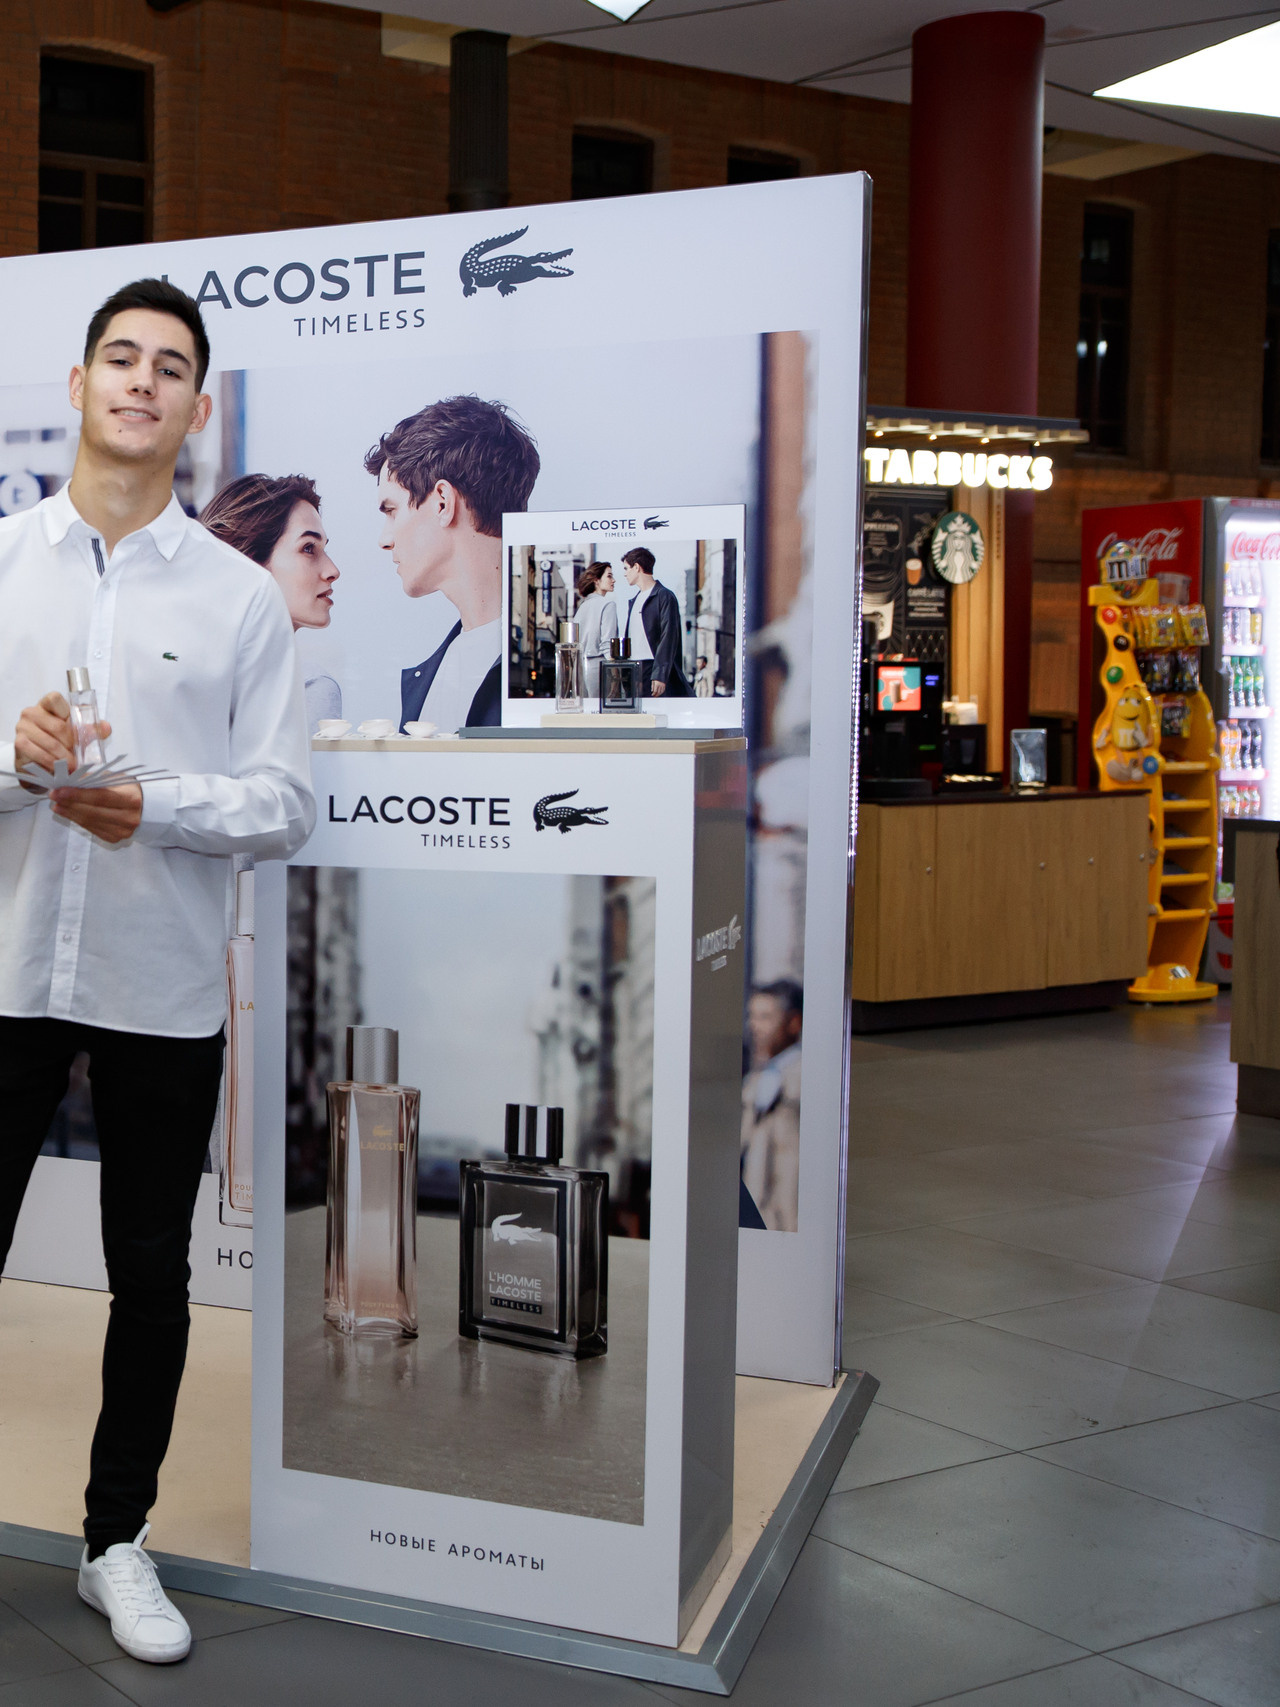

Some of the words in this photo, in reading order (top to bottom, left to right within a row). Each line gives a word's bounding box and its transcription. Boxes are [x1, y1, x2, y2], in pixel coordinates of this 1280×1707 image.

[161, 251, 426, 310] ACOSTE
[294, 308, 426, 337] TIMELESS
[864, 447, 1054, 491] TARBUCKS
[571, 519, 637, 531] LACOSTE
[328, 795, 511, 826] LACOSTE
[420, 834, 511, 849] TIMELESS
[360, 1141, 405, 1151] LACOSTE
[488, 1271, 542, 1290] L'HOMME
[488, 1283, 542, 1302] LACOSTE
[490, 1297, 541, 1313] TIMELESS
[370, 1529, 436, 1552] НОВЫЕ
[448, 1543, 544, 1571] АРОМАТЫ
